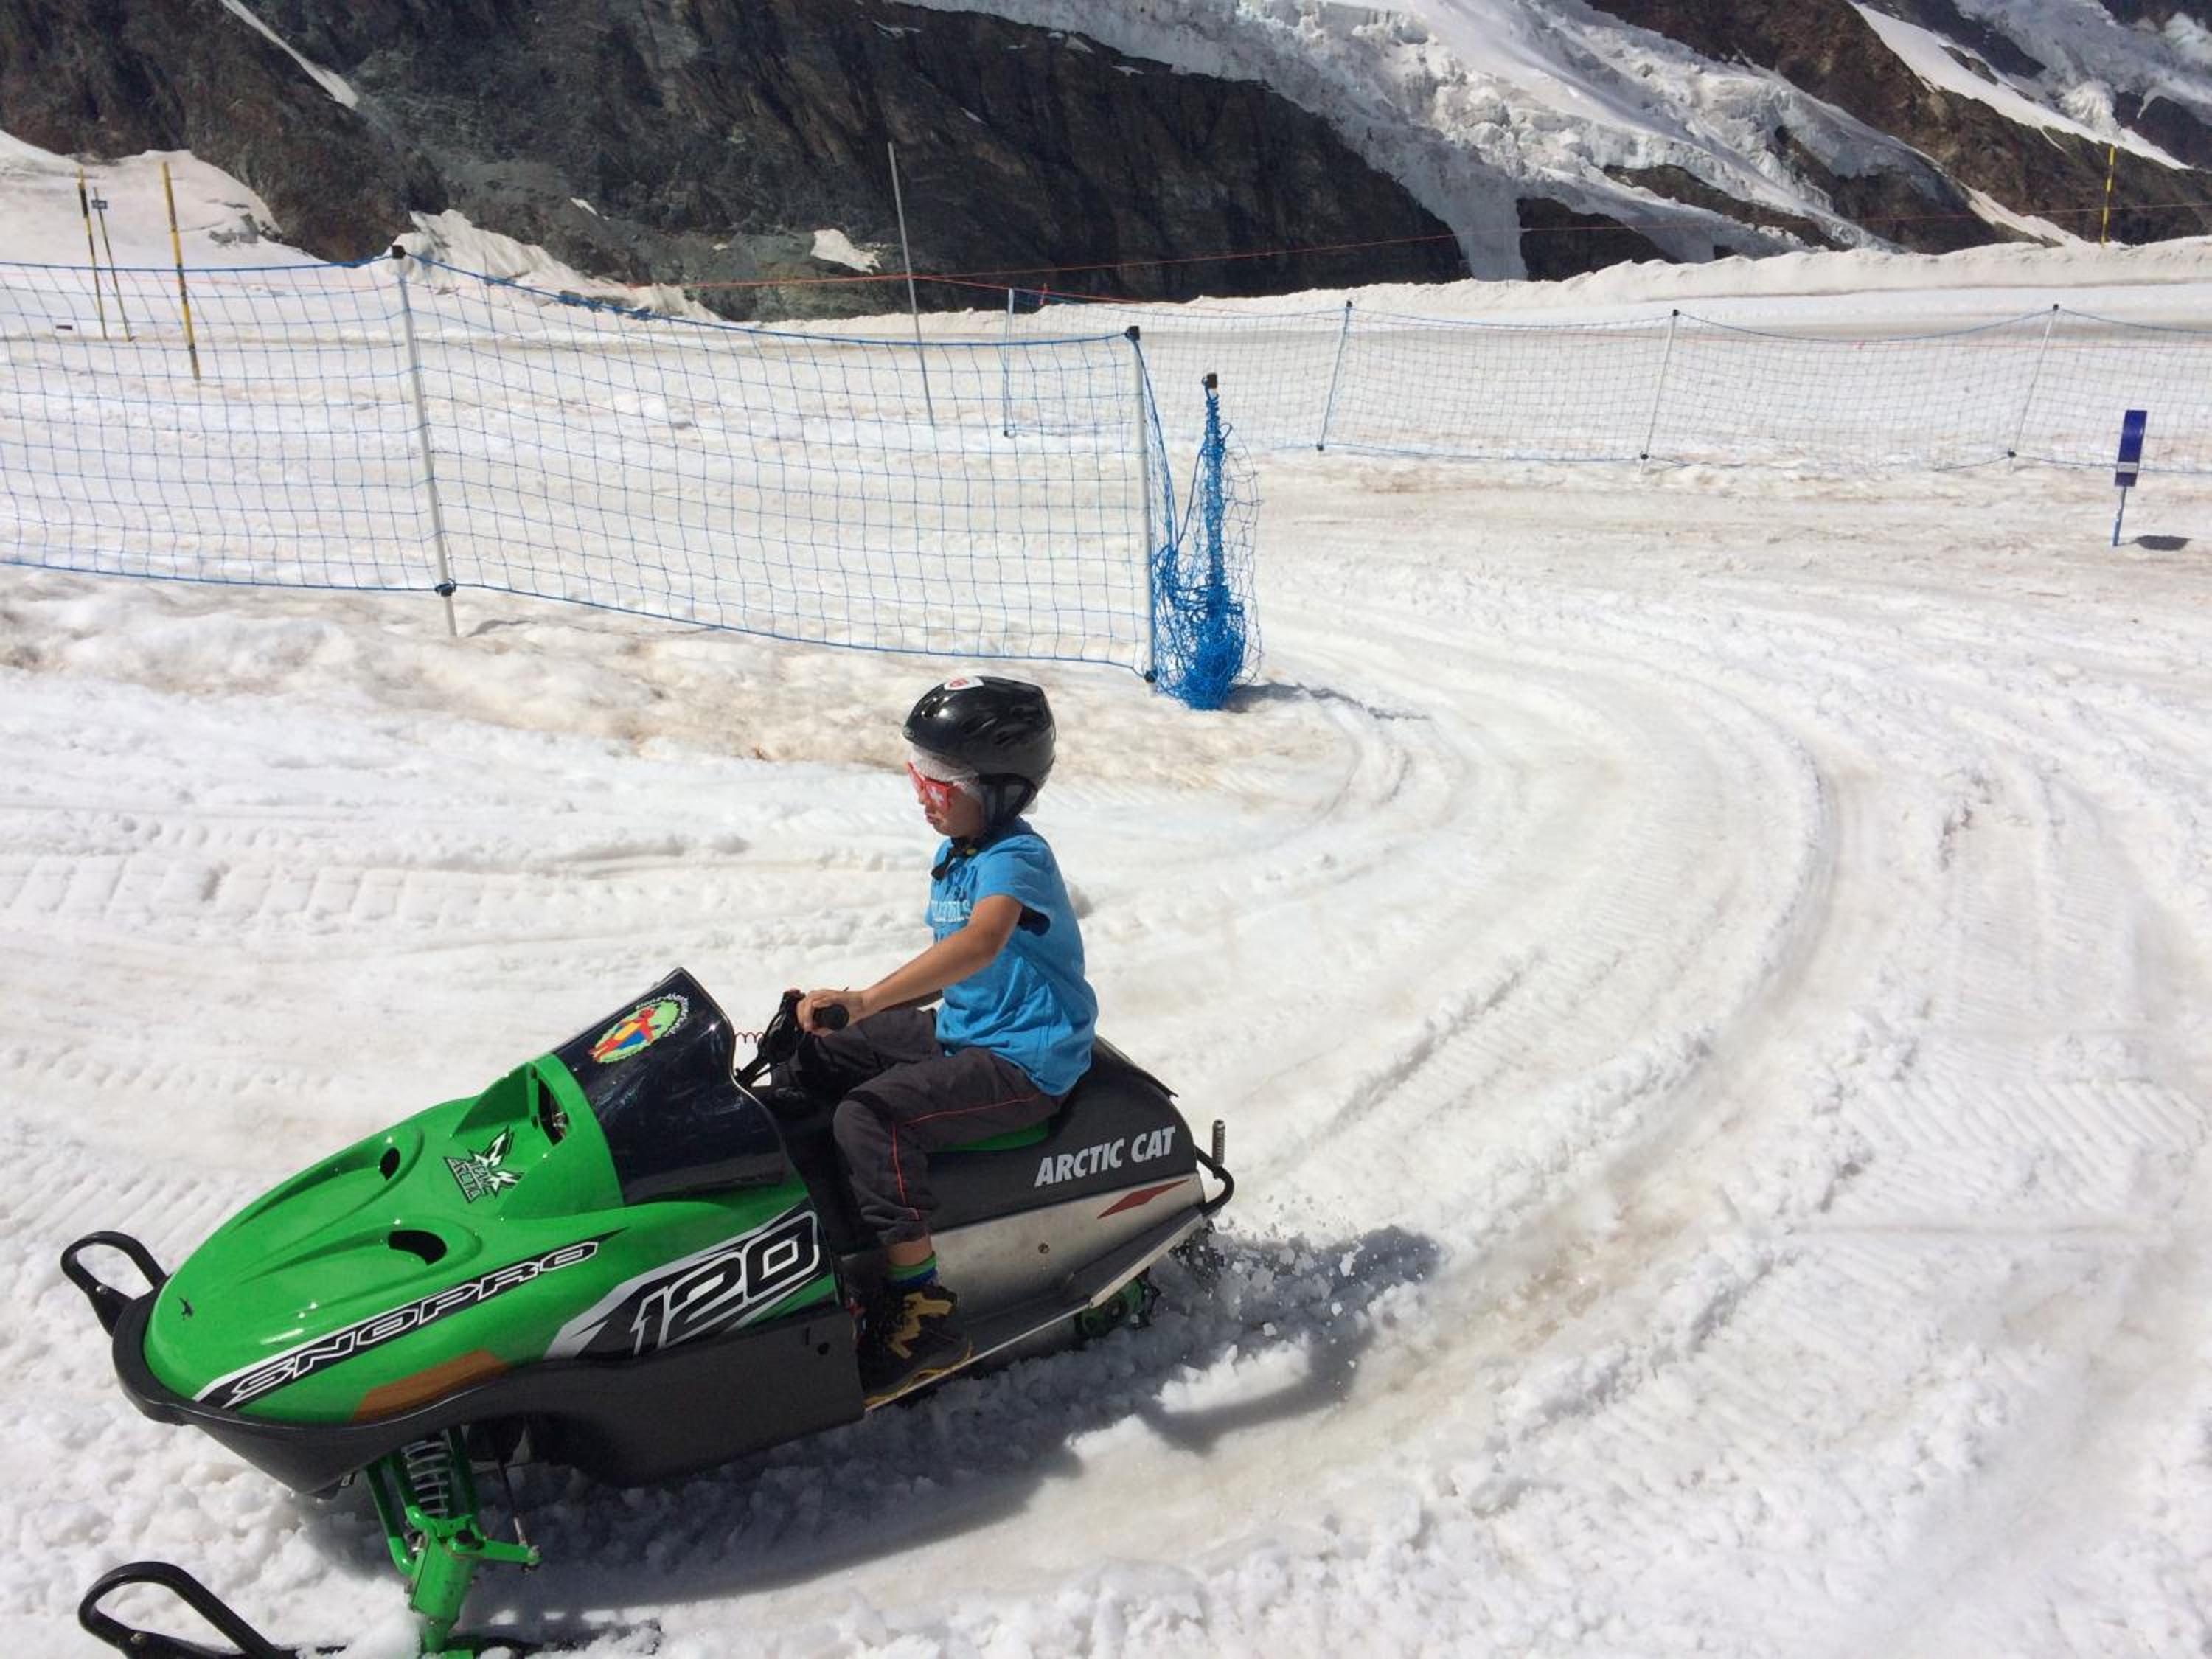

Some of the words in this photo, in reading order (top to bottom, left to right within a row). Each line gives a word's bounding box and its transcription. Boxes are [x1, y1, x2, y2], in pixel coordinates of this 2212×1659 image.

[1034, 1138, 1124, 1187] ARCTIC
[1131, 1126, 1176, 1163] CAT
[223, 1242, 599, 1409] SNOPRO
[629, 1210, 819, 1357] 120
